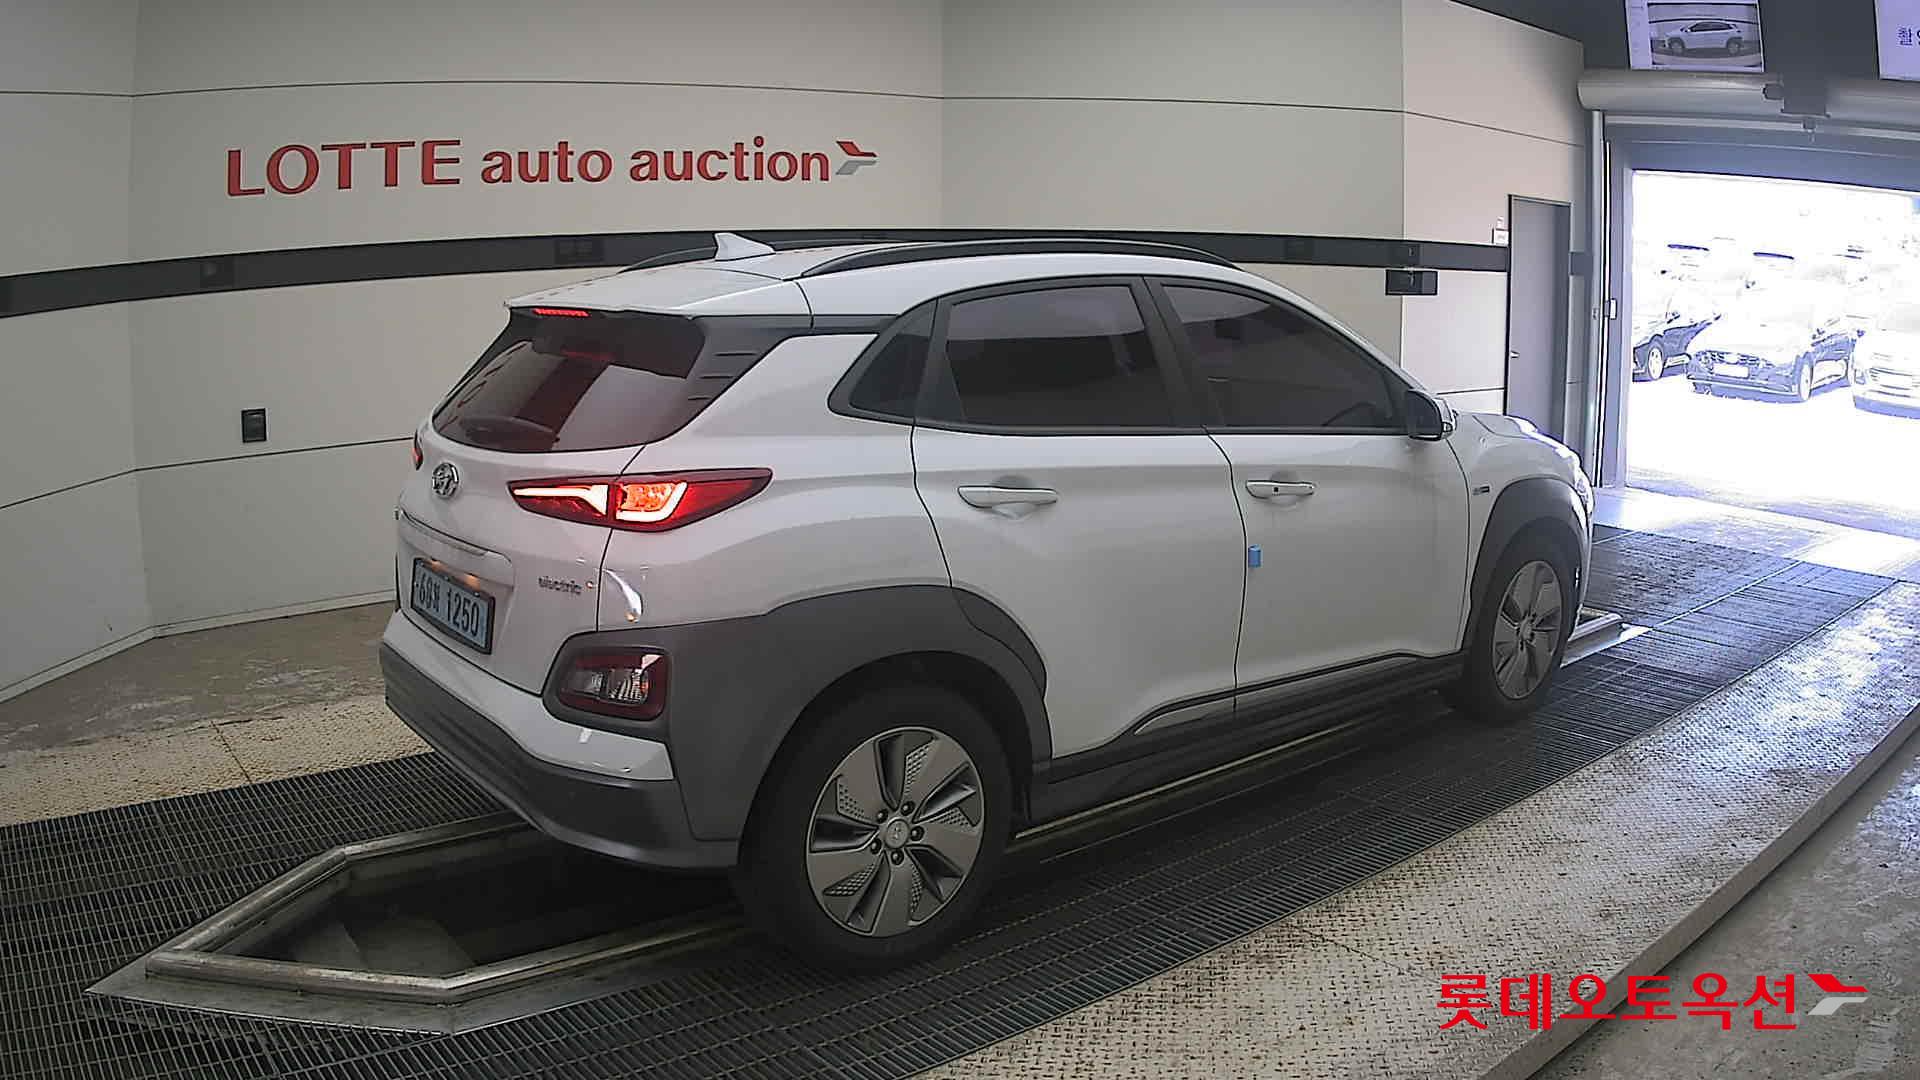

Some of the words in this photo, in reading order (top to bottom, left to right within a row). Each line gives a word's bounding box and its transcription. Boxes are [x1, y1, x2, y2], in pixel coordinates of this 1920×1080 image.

[227, 139, 461, 197] LOTTE
[480, 140, 613, 184] auto
[629, 135, 831, 183] auction
[447, 587, 480, 637] 1250
